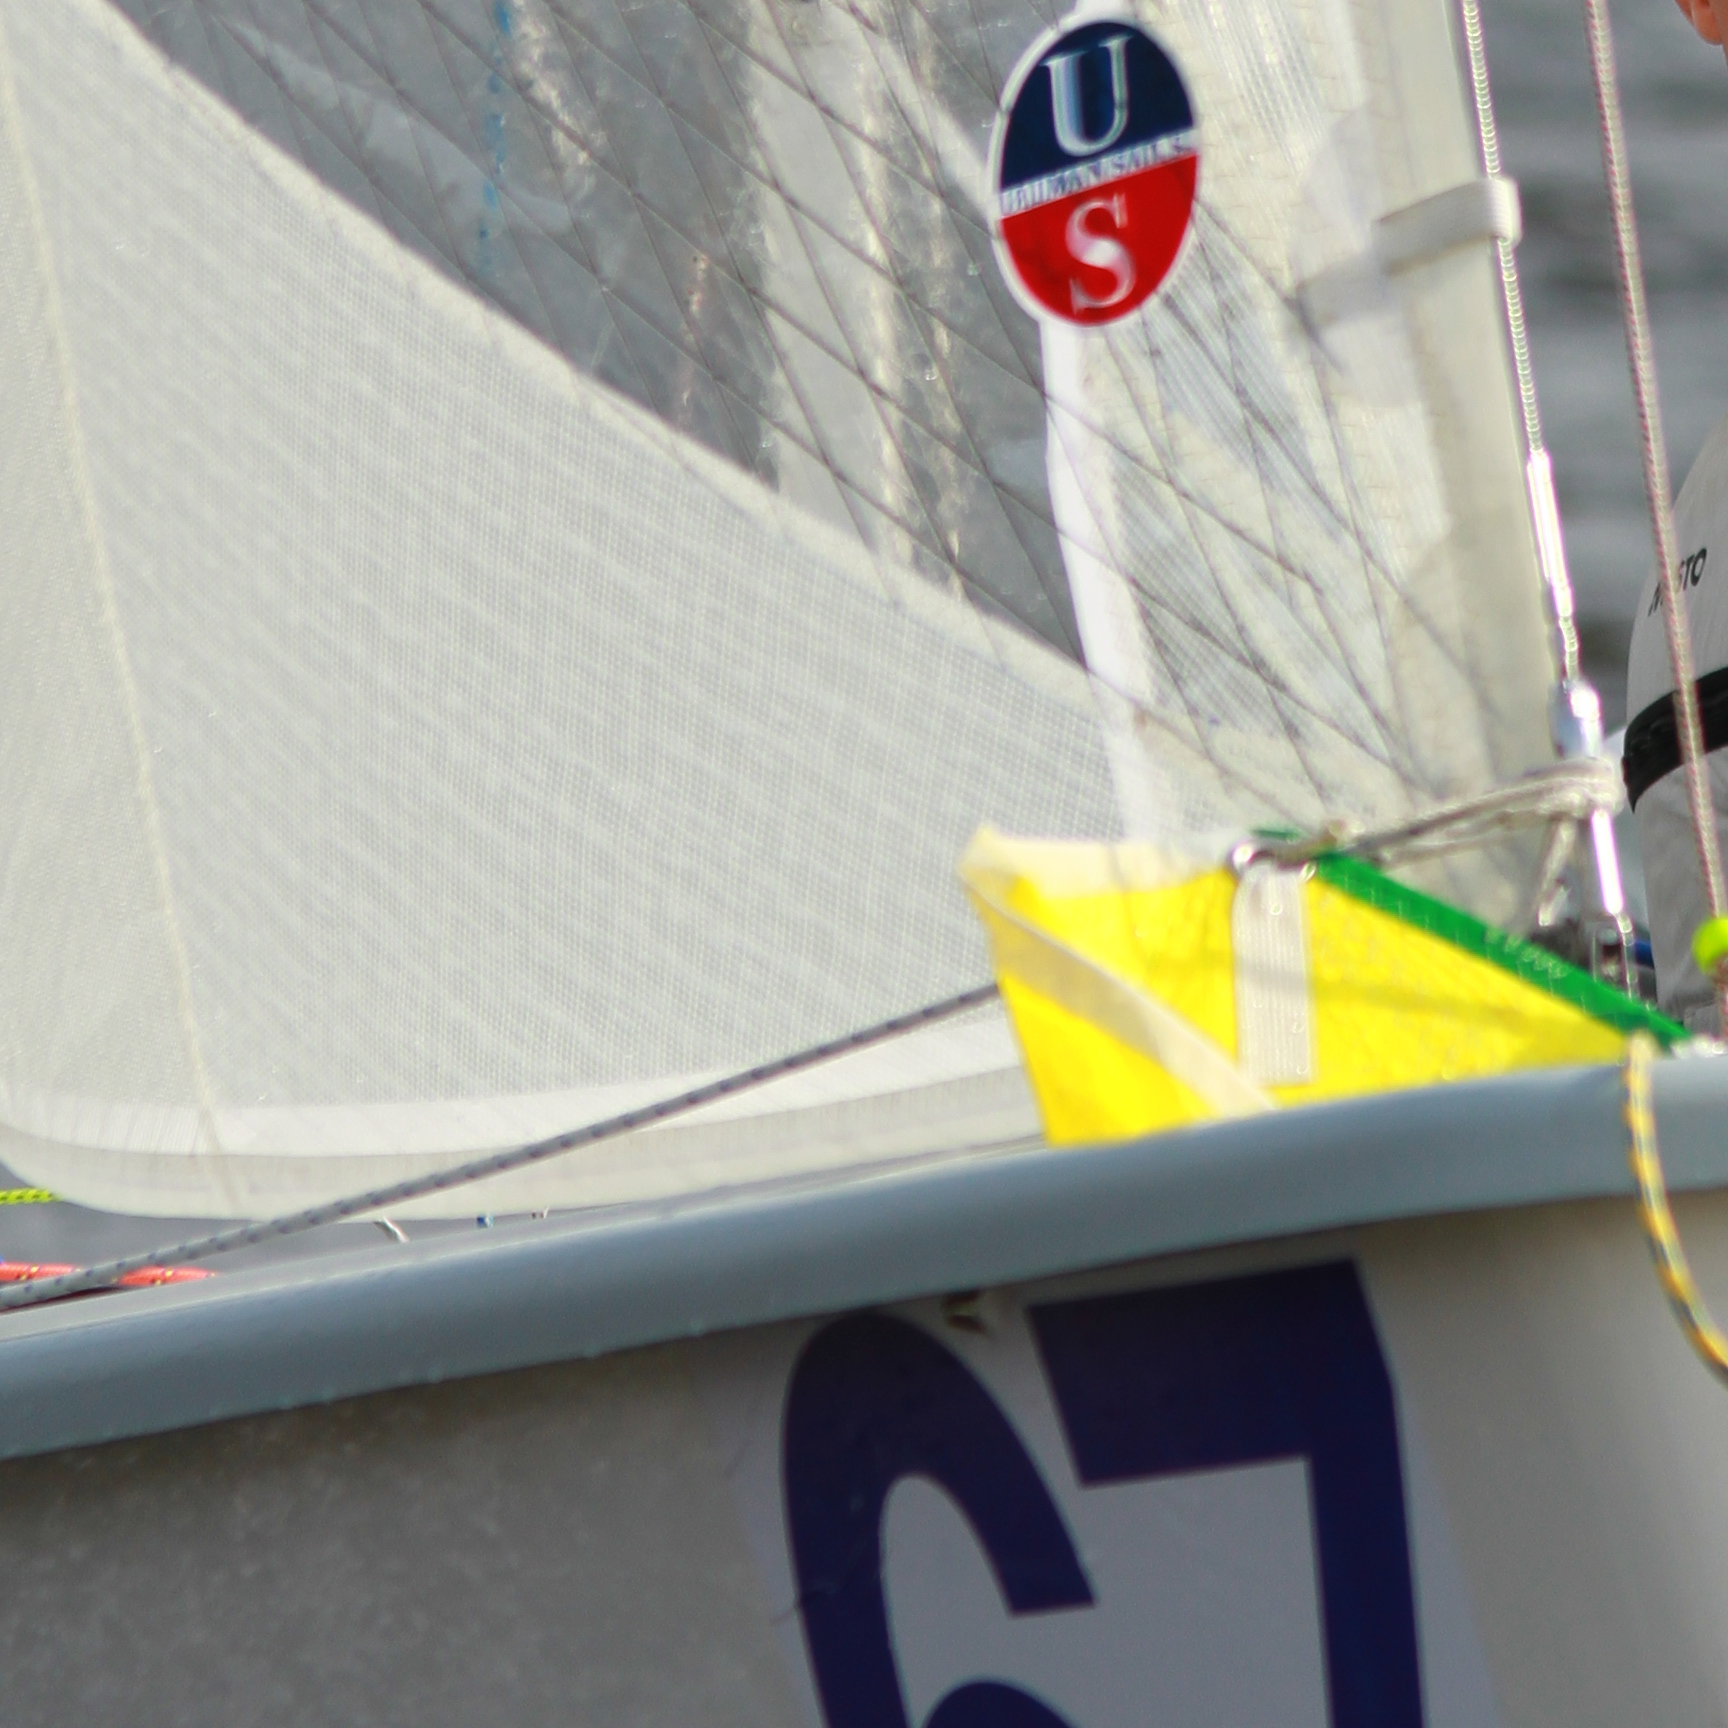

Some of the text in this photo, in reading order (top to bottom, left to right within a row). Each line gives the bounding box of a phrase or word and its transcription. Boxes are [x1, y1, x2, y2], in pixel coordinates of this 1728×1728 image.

[1040, 34, 1134, 157] U
[1064, 192, 1137, 315] S
[1647, 547, 1708, 617] MSTO
